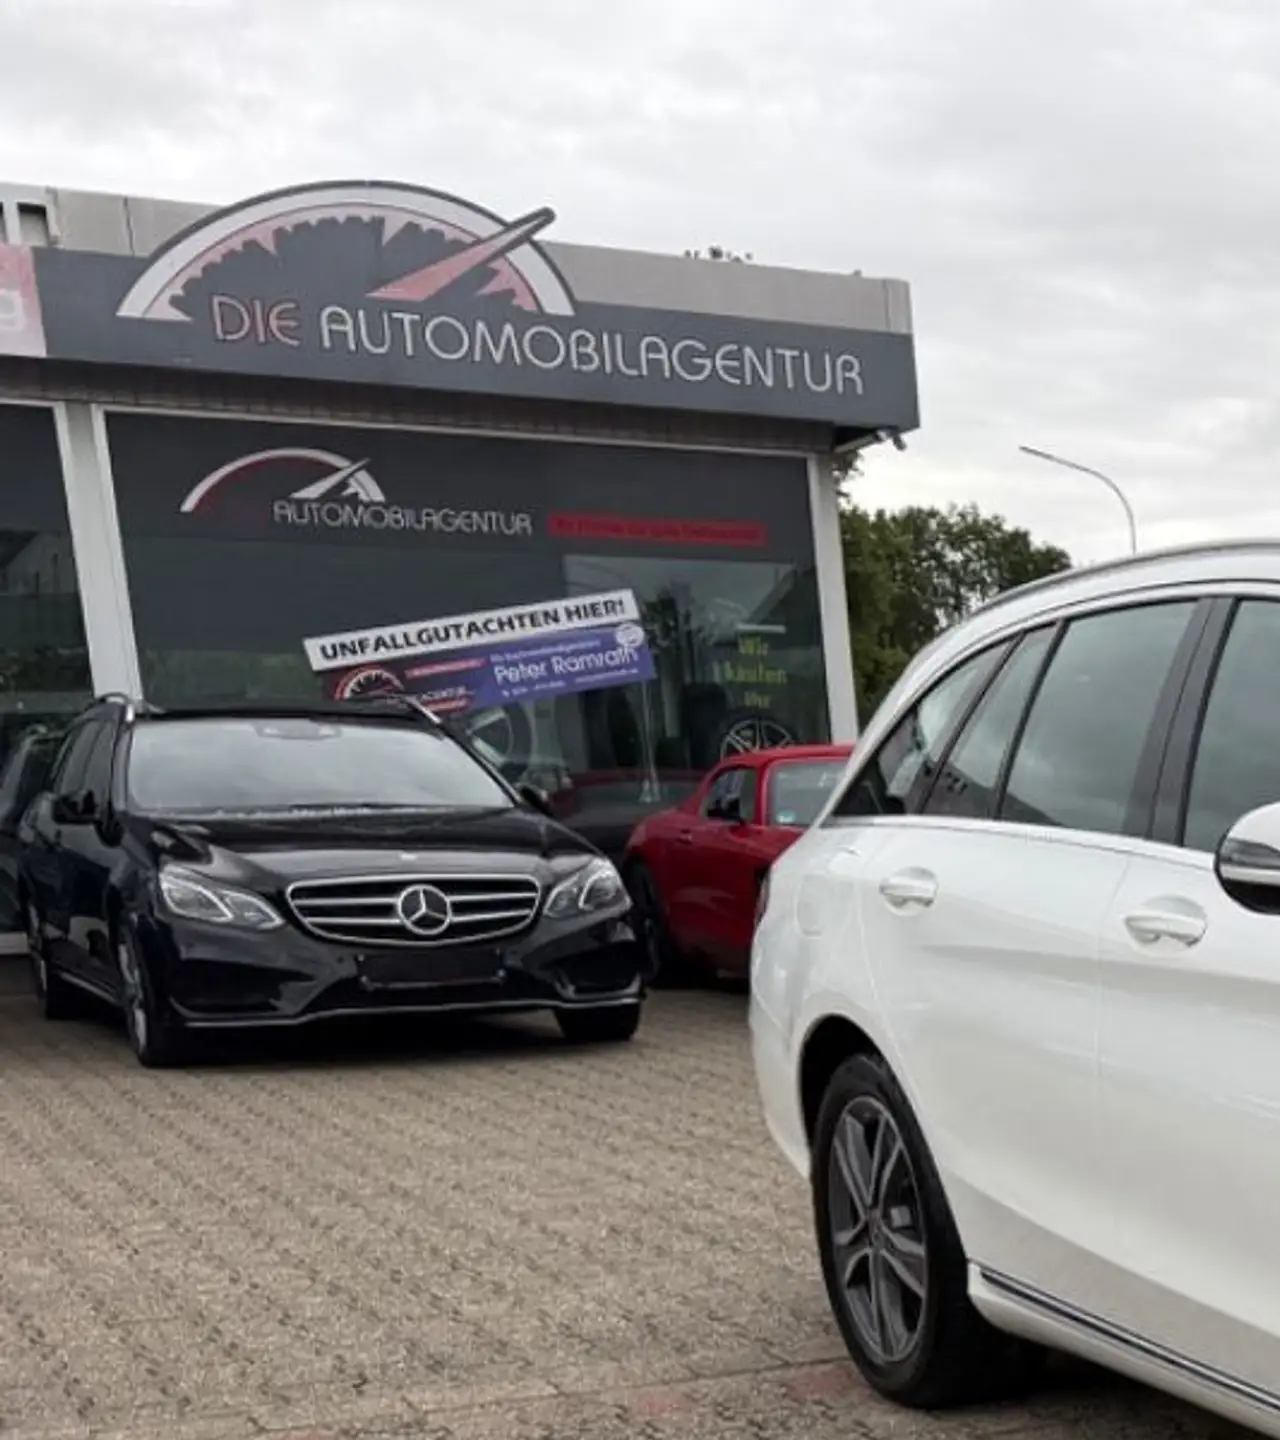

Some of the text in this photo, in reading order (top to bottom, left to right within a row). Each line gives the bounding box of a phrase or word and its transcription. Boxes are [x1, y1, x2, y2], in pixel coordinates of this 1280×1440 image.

[211, 295, 866, 396] DIE AUTOMOBILAGENTUR
[273, 499, 534, 537] AUTOMOBILAGENTUR
[319, 610, 560, 660] UNFALLGUTACHTEN
[564, 599, 626, 623] HIER!
[494, 657, 547, 685] Peter
